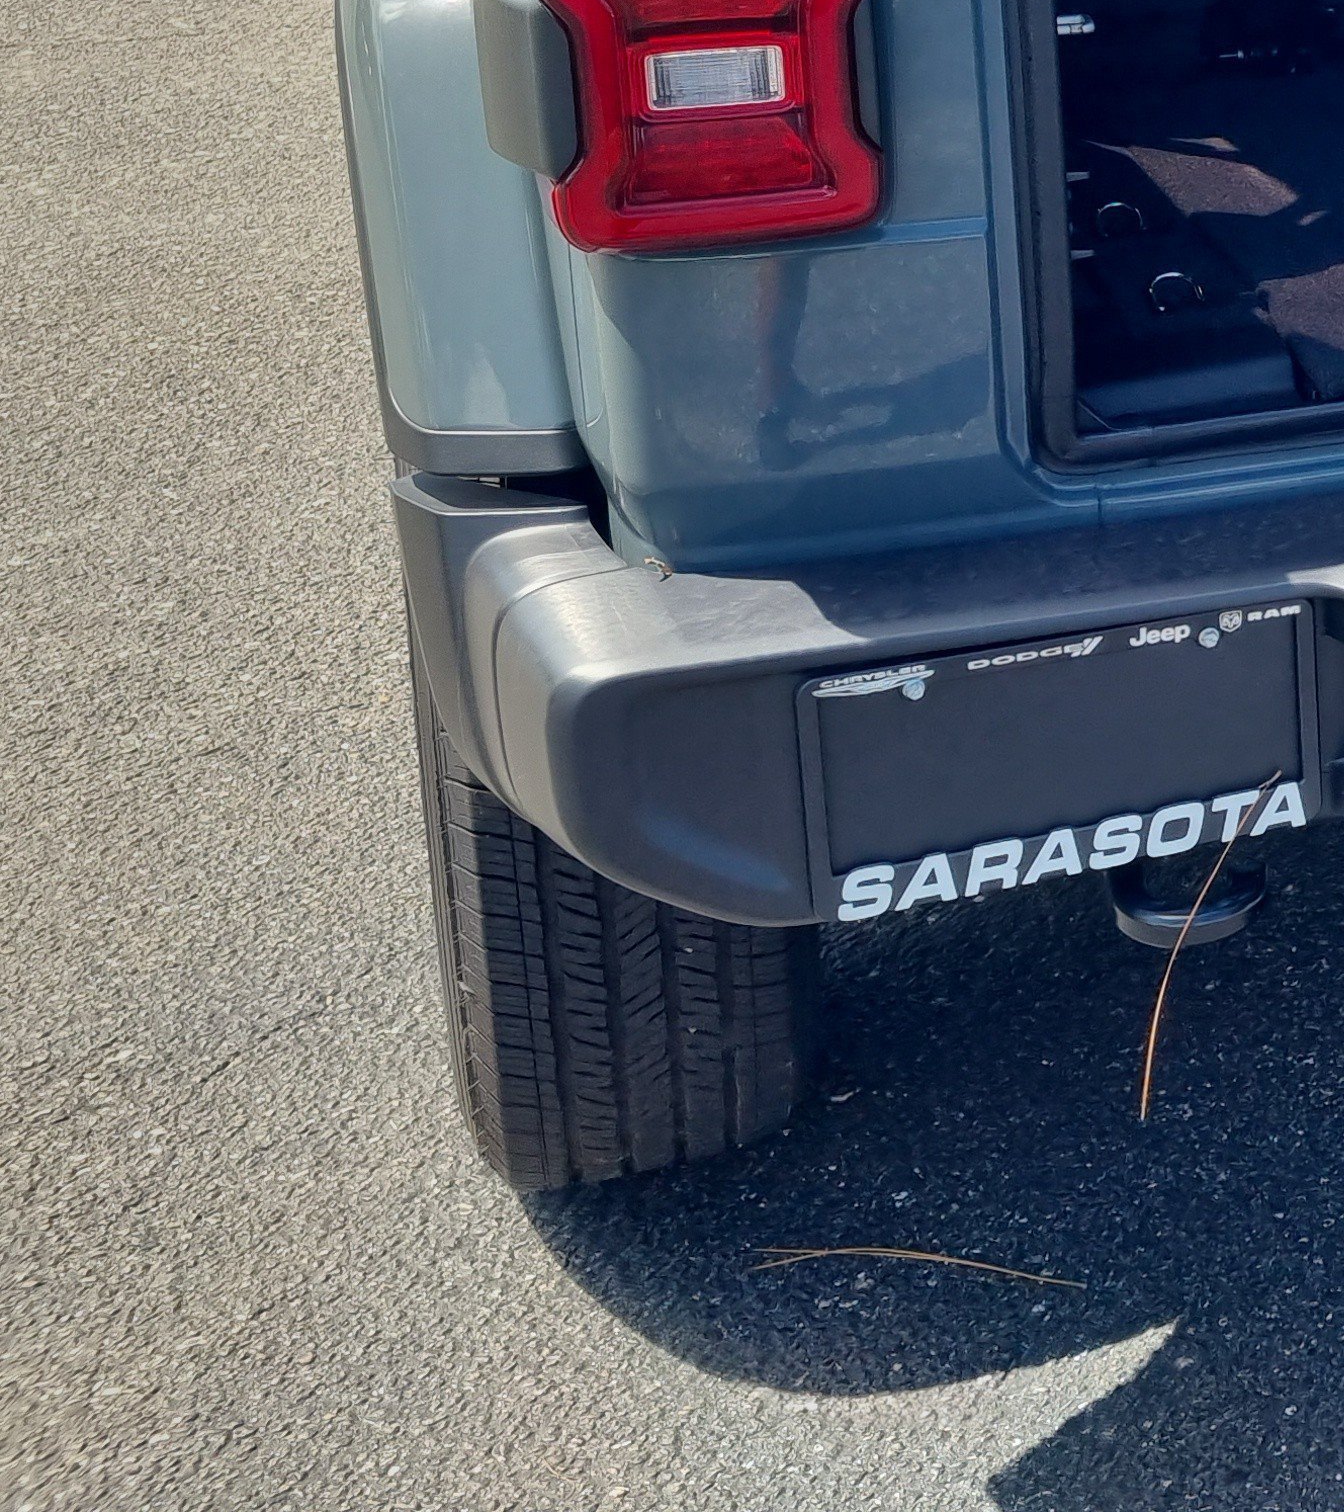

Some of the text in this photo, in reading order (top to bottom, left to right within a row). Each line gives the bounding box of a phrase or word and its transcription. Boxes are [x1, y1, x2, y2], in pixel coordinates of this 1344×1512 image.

[1246, 604, 1302, 622] RAM
[1129, 622, 1191, 647] Jeep
[966, 643, 1084, 671] DODGE
[818, 664, 926, 690] CHRYSLER
[837, 781, 1307, 923] SARASOTA
